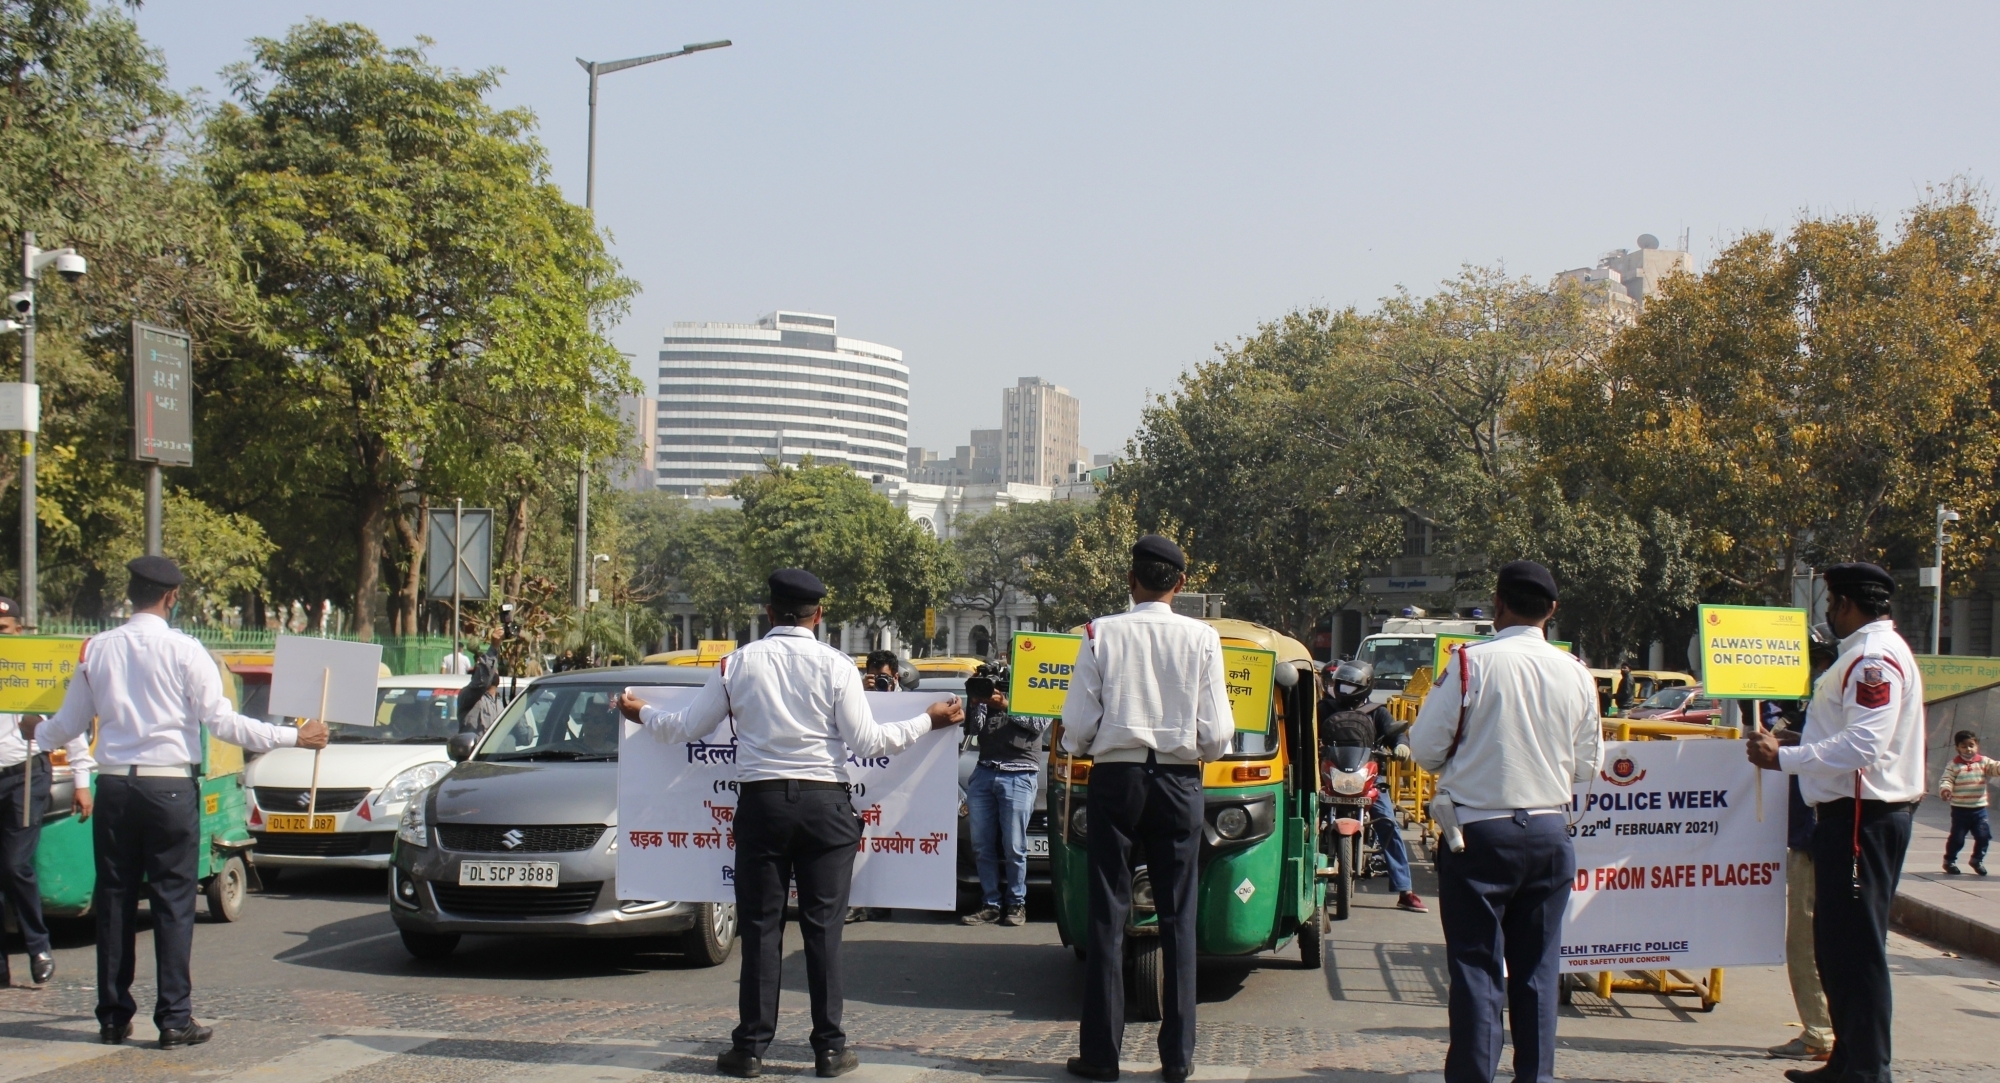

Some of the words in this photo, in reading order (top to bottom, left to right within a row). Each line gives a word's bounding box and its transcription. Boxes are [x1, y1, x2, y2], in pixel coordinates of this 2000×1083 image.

[1711, 637, 1763, 650] ALWAYS
[1766, 639, 1801, 651] WALK
[32, 660, 53, 673] मार्ग
[1713, 653, 1732, 664] ON
[1736, 654, 1801, 666] FOOTPATH
[1228, 668, 1251, 681] कभी
[1941, 661, 1974, 676] स्टेशन
[35, 676, 57, 689] मार्ग
[1028, 676, 1069, 691] SAFE
[1586, 791, 1662, 812] POLICE
[1668, 790, 1729, 809] WEEK
[311, 818, 333, 828] 087
[1581, 817, 1611, 837] 22nd
[1615, 822, 1682, 836] FEBRUARY
[1685, 821, 1719, 836] 2021)
[629, 831, 664, 850] सड़क
[667, 832, 689, 849] पार
[692, 827, 722, 850] करने
[871, 832, 916, 854] उपयोग
[470, 867, 485, 881] DL
[490, 867, 515, 882] 5CP
[519, 867, 553, 882] 3688
[1595, 867, 1645, 891] FROM
[1651, 865, 1696, 889] SAFE
[1702, 862, 1780, 887] PLACES"
[1560, 945, 1588, 956] ELHI
[1591, 943, 1642, 954] TRAFFIC
[1645, 940, 1689, 951] POLICE
[1636, 955, 1670, 963] CONCERN
